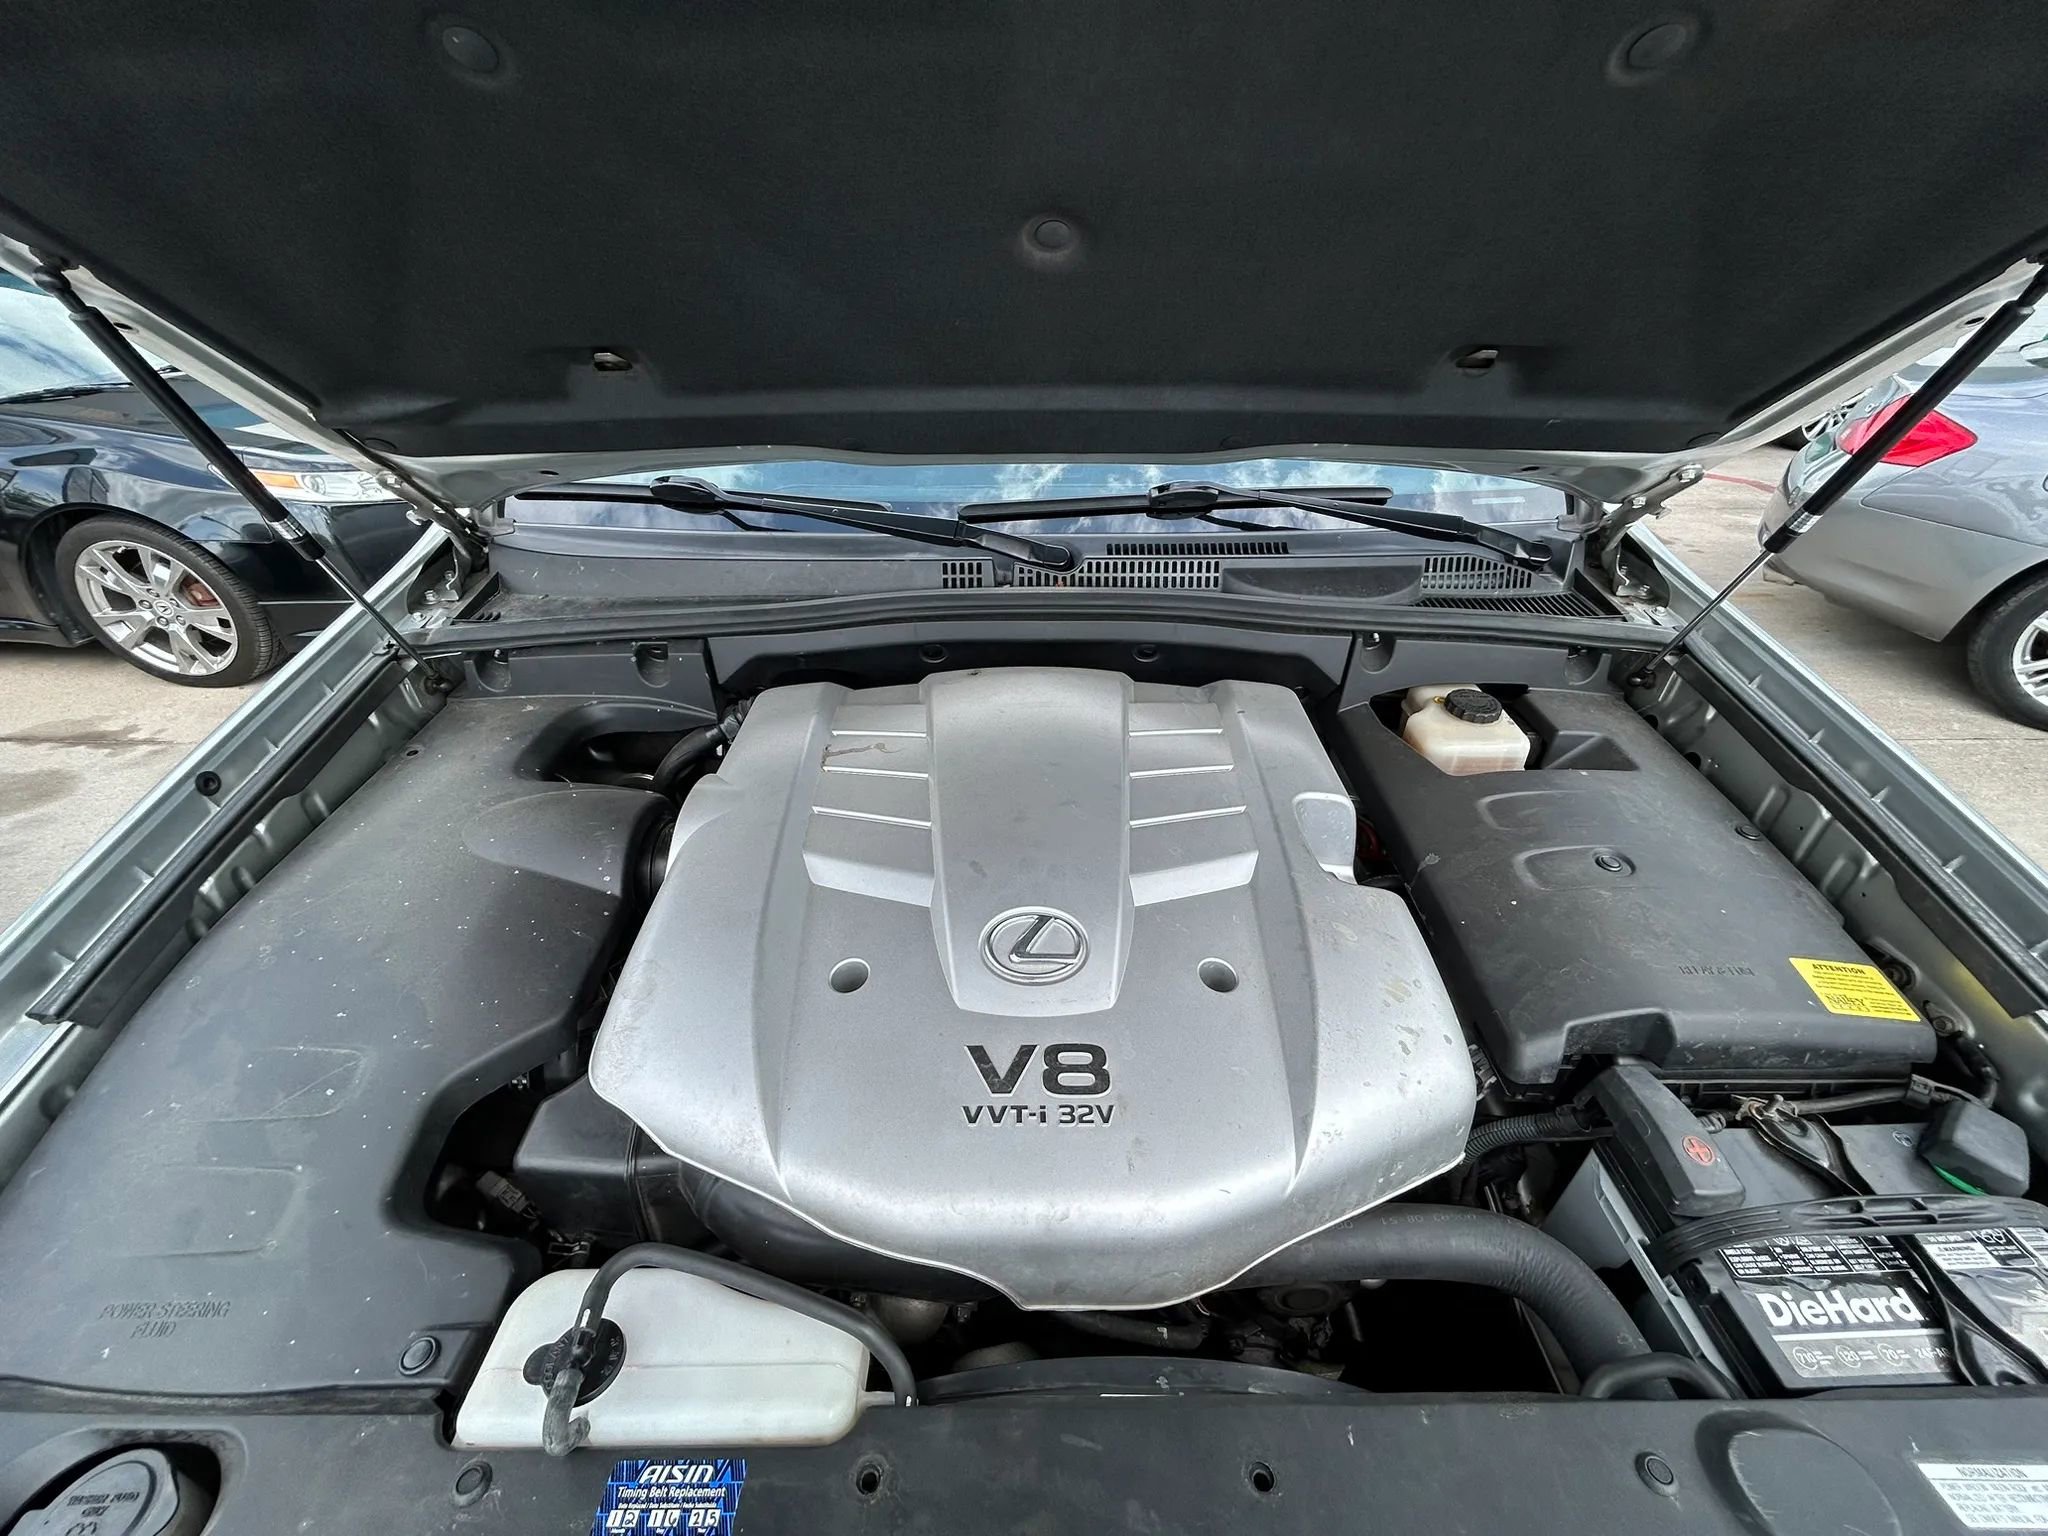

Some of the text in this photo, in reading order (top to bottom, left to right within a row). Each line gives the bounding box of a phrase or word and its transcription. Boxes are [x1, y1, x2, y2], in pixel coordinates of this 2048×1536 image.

[1812, 963, 1866, 974] ATTENTION
[966, 1043, 1111, 1096] V8
[962, 1104, 1114, 1124] VVT-i 32V
[99, 1301, 231, 1319] POWER STEERING
[1755, 1288, 1925, 1327] DieHard
[130, 1320, 177, 1338] FLUID
[638, 1465, 715, 1484] AISIN
[617, 1486, 726, 1499] Timing Belt Replacement
